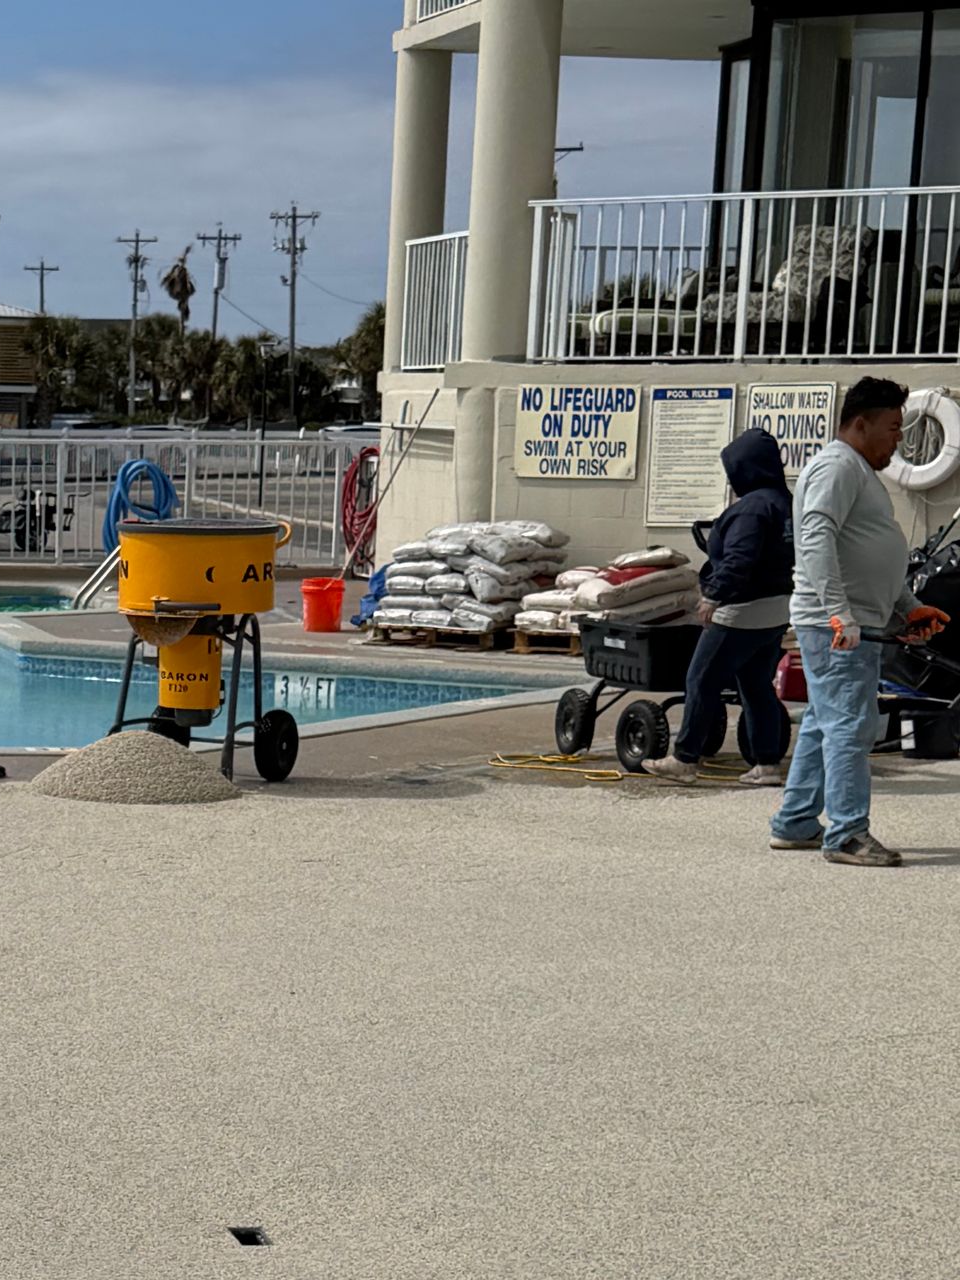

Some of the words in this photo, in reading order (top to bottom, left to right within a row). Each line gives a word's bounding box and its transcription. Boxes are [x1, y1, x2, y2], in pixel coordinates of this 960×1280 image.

[521, 387, 543, 412] NO
[550, 387, 636, 413] LIFEGUARD
[666, 390, 689, 399] POOL
[692, 390, 719, 398] RULES
[752, 392, 795, 409] SHALLOW
[798, 391, 828, 409] WATER
[542, 413, 563, 438] ON
[570, 414, 612, 438] DUTY
[777, 414, 826, 439] DIVING
[524, 440, 558, 457] SWIM
[565, 441, 583, 457] AT
[589, 441, 627, 458] YOUR
[539, 458, 571, 475] OWN
[577, 459, 608, 476] RISK
